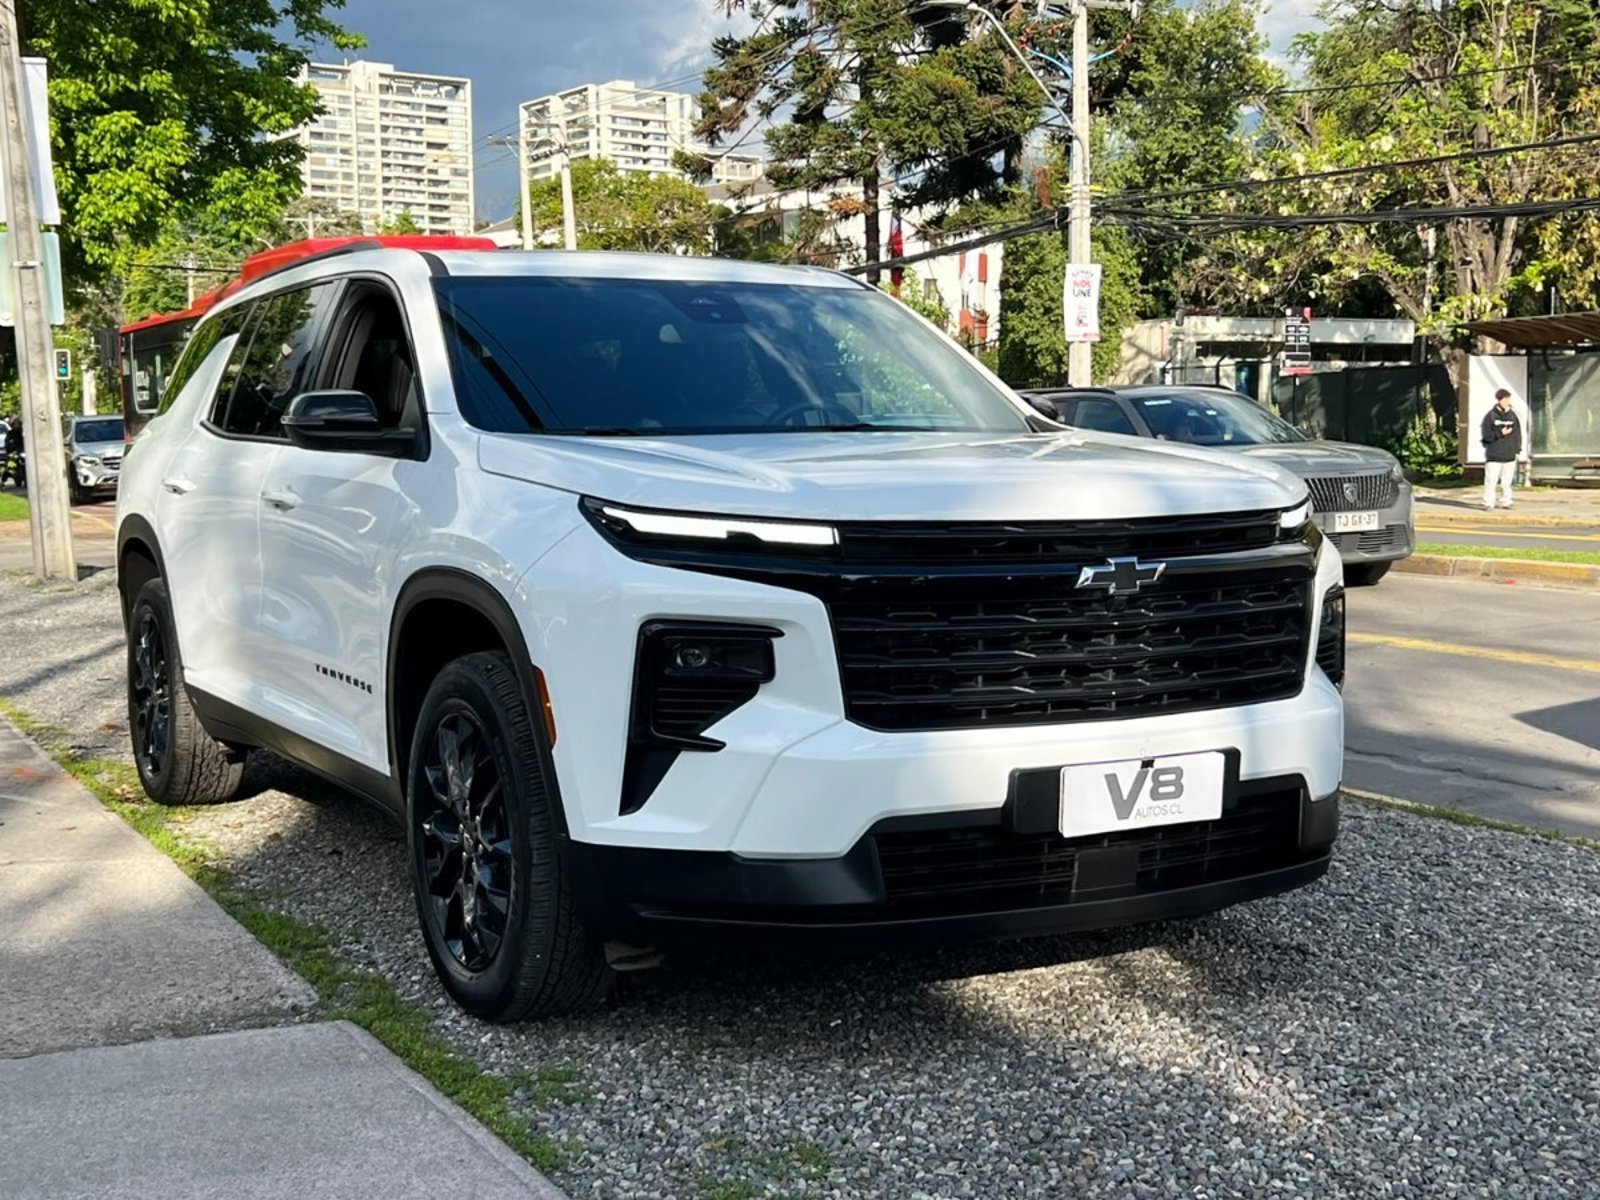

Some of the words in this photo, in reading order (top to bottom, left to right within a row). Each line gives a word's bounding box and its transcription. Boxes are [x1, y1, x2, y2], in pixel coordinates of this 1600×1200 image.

[1072, 288, 1092, 298] UNE
[314, 663, 373, 695] TRAVERSE
[1104, 766, 1184, 821] V8
[1134, 803, 1184, 820] AUTOS.CL
